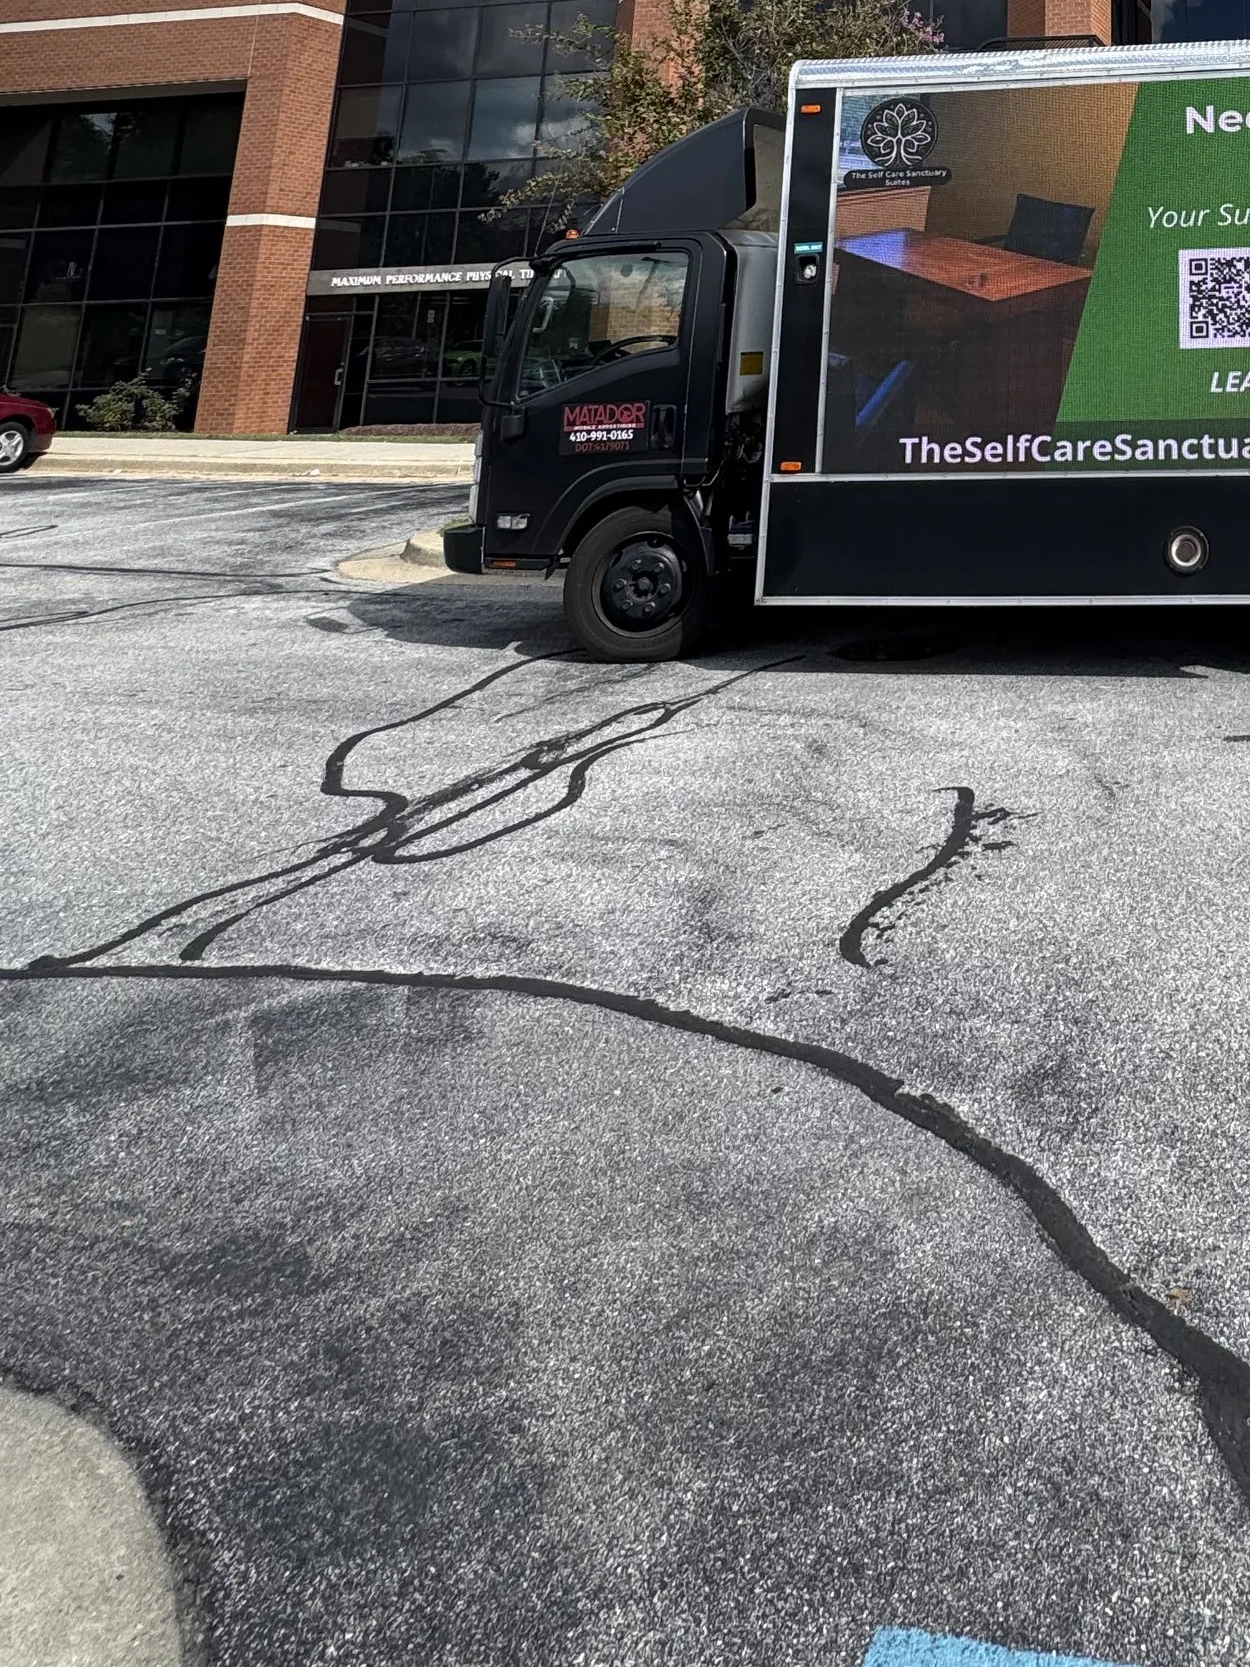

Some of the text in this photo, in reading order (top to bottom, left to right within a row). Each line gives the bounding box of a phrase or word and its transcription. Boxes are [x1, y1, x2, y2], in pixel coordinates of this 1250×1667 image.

[868, 170, 884, 179] Self
[885, 170, 905, 178] Care
[906, 169, 947, 178] Sanctuary
[1148, 206, 1211, 229] Your
[331, 275, 382, 287] MAXIMUM
[385, 272, 463, 285] PERFORMANCE
[564, 403, 646, 426] MATADOR
[569, 429, 634, 442] 410-991-0165
